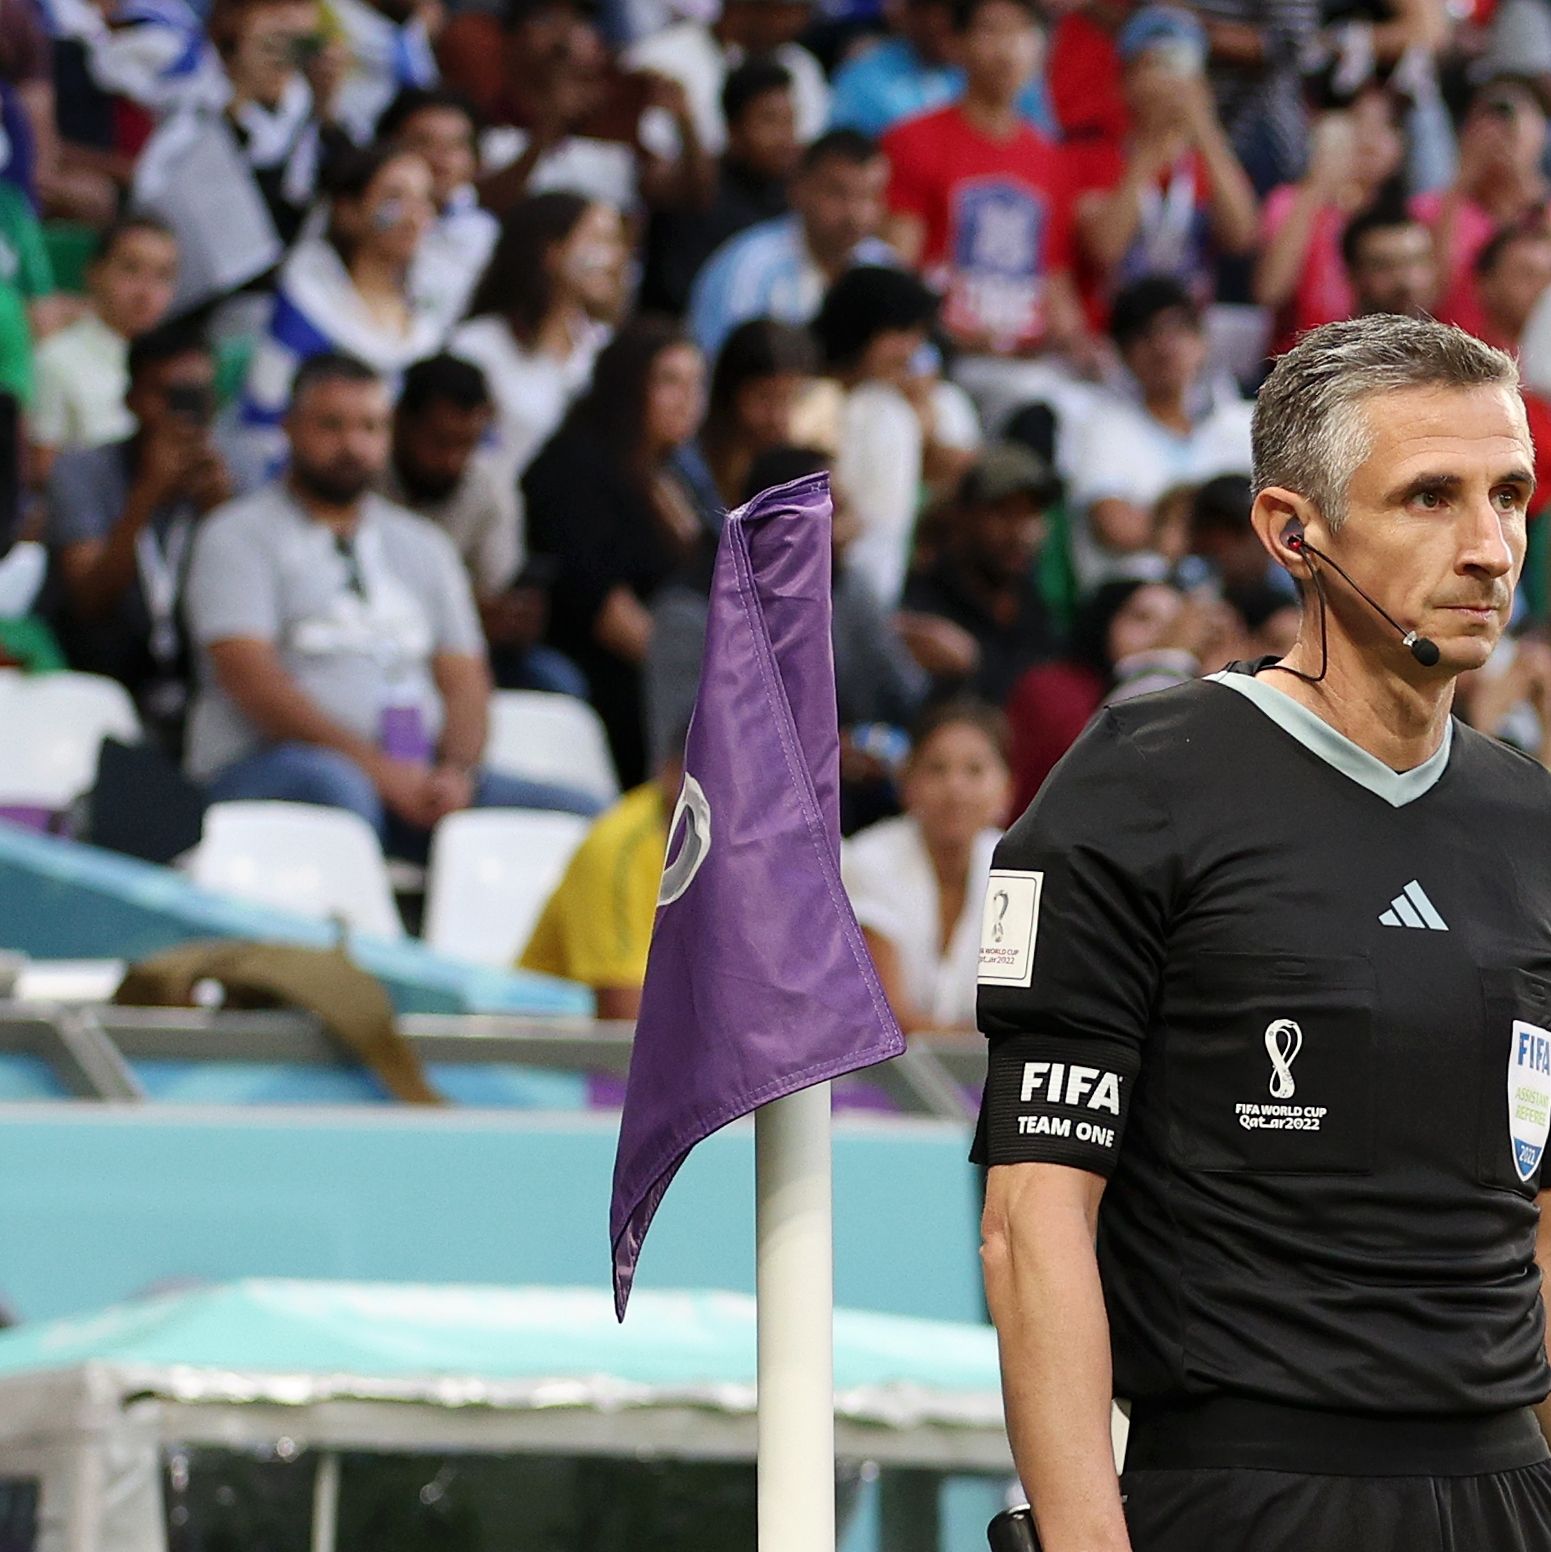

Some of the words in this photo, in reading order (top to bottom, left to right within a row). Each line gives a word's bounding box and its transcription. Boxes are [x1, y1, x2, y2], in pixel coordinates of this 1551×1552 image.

[1518, 1032, 1550, 1076] FIFA
[1020, 1062, 1120, 1116] FIFA
[1235, 1103, 1260, 1116] FIFA
[1260, 1104, 1303, 1117] WORLD
[1303, 1106, 1327, 1118] CUP
[1018, 1116, 1071, 1138] TEAM
[1075, 1122, 1115, 1148] ONE
